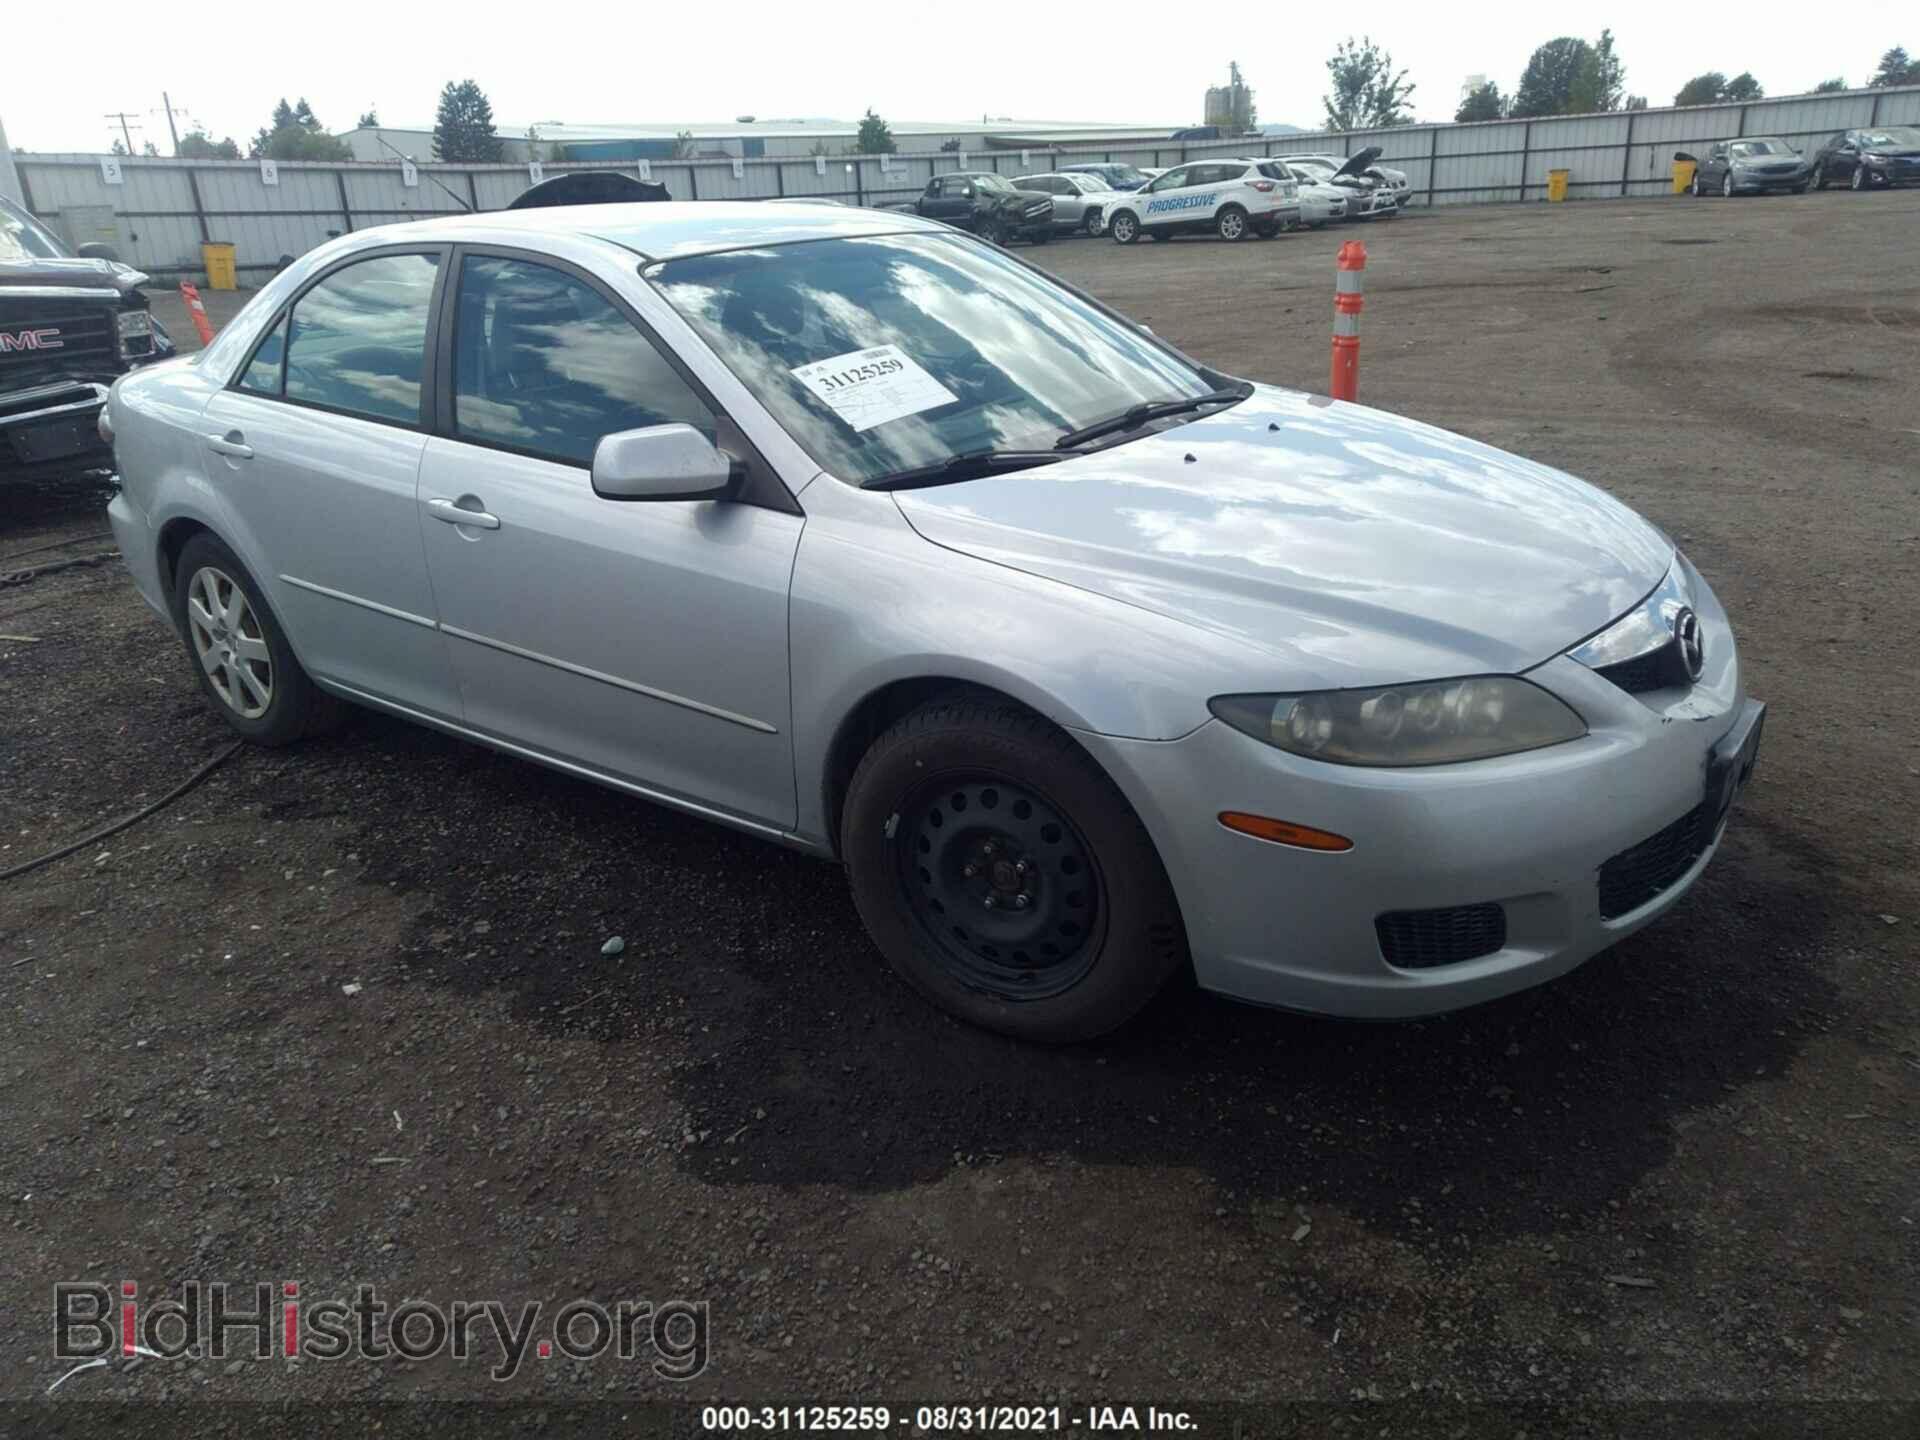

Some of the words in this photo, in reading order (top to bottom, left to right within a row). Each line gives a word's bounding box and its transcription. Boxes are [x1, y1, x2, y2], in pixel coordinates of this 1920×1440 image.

[107, 164, 116, 177] 5
[1146, 192, 1217, 214] PROGRESSIVE
[0, 328, 64, 352] MC
[818, 358, 904, 391] 31125259
